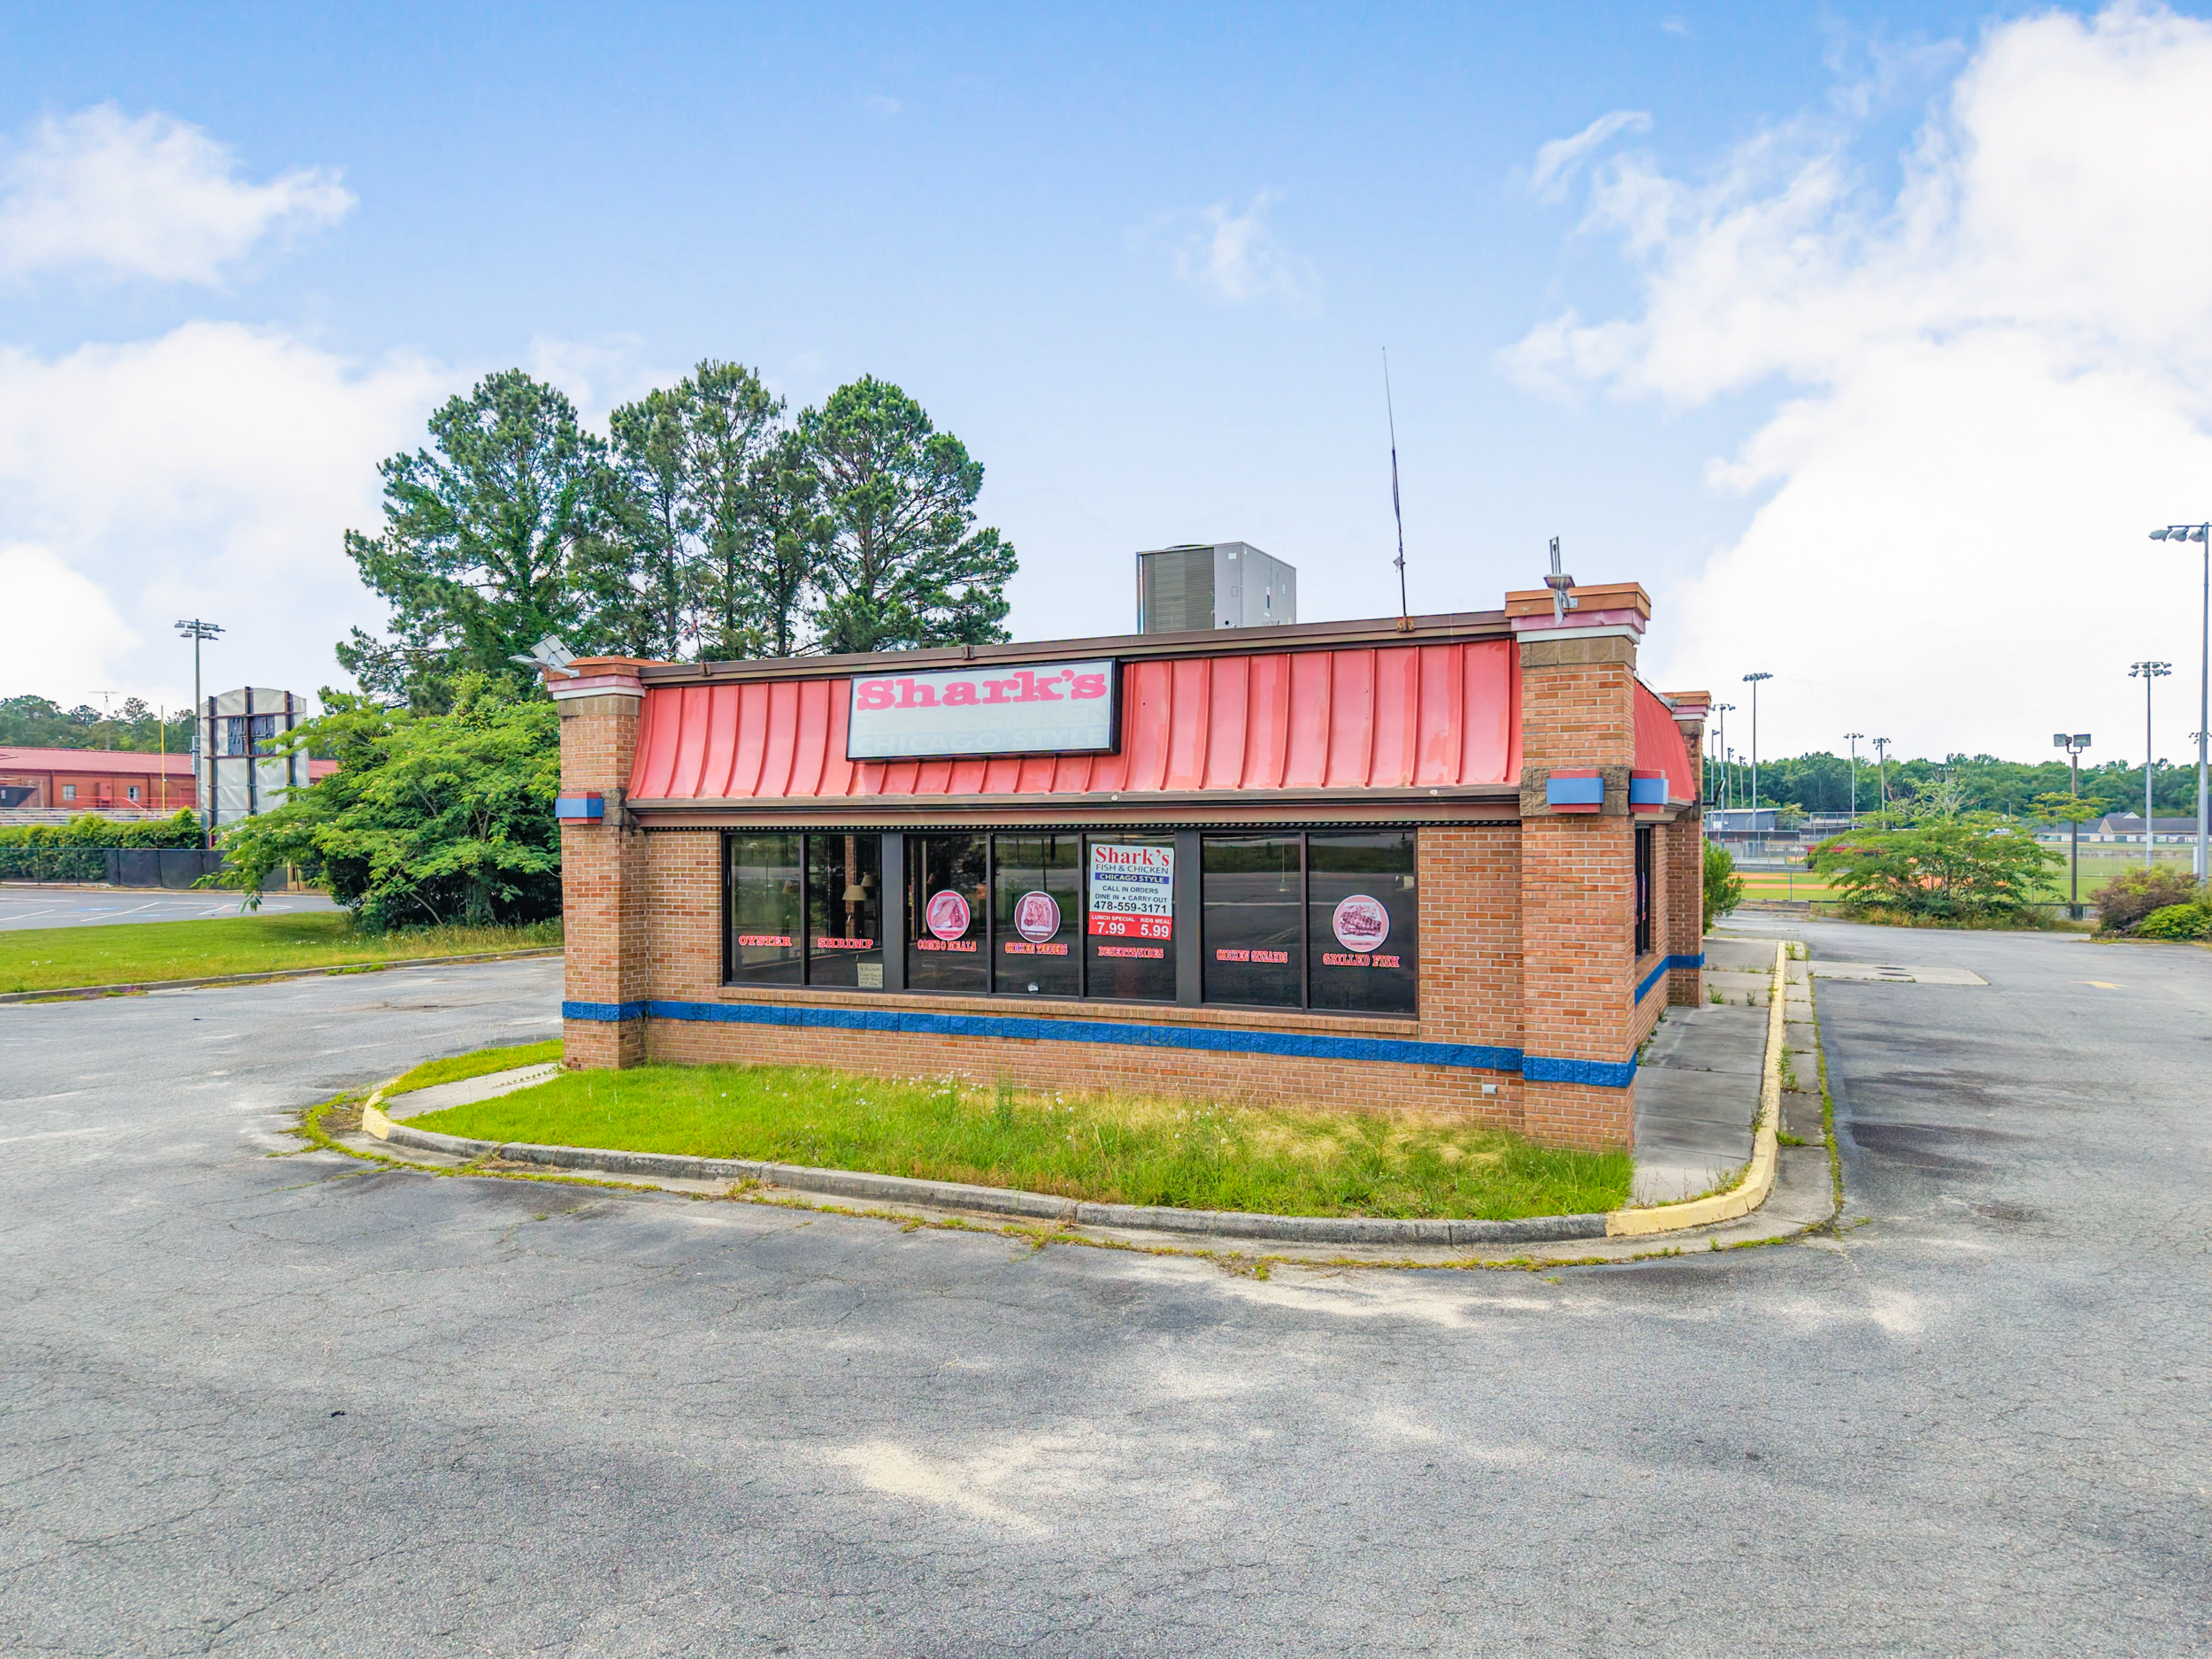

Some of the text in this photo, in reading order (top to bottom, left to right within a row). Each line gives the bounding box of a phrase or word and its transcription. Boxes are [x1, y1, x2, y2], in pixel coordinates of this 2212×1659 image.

[856, 669, 1108, 711] Shark's
[855, 727, 1103, 753] CHICAGO STYLE
[1094, 846, 1170, 867] Shark's
[1126, 865, 1169, 874] CHICKEN
[1094, 900, 1167, 914] 478-559-3171
[1097, 922, 1169, 938] 7.99 5.99
[738, 935, 792, 947] OYSTER
[817, 937, 873, 949] SHRIMP
[947, 941, 978, 952] MEALS
[1005, 941, 1069, 956] CHICKEN TENDERS
[1216, 949, 1249, 962] CHICKEN
[1322, 953, 1400, 968] GRILLED FISH
